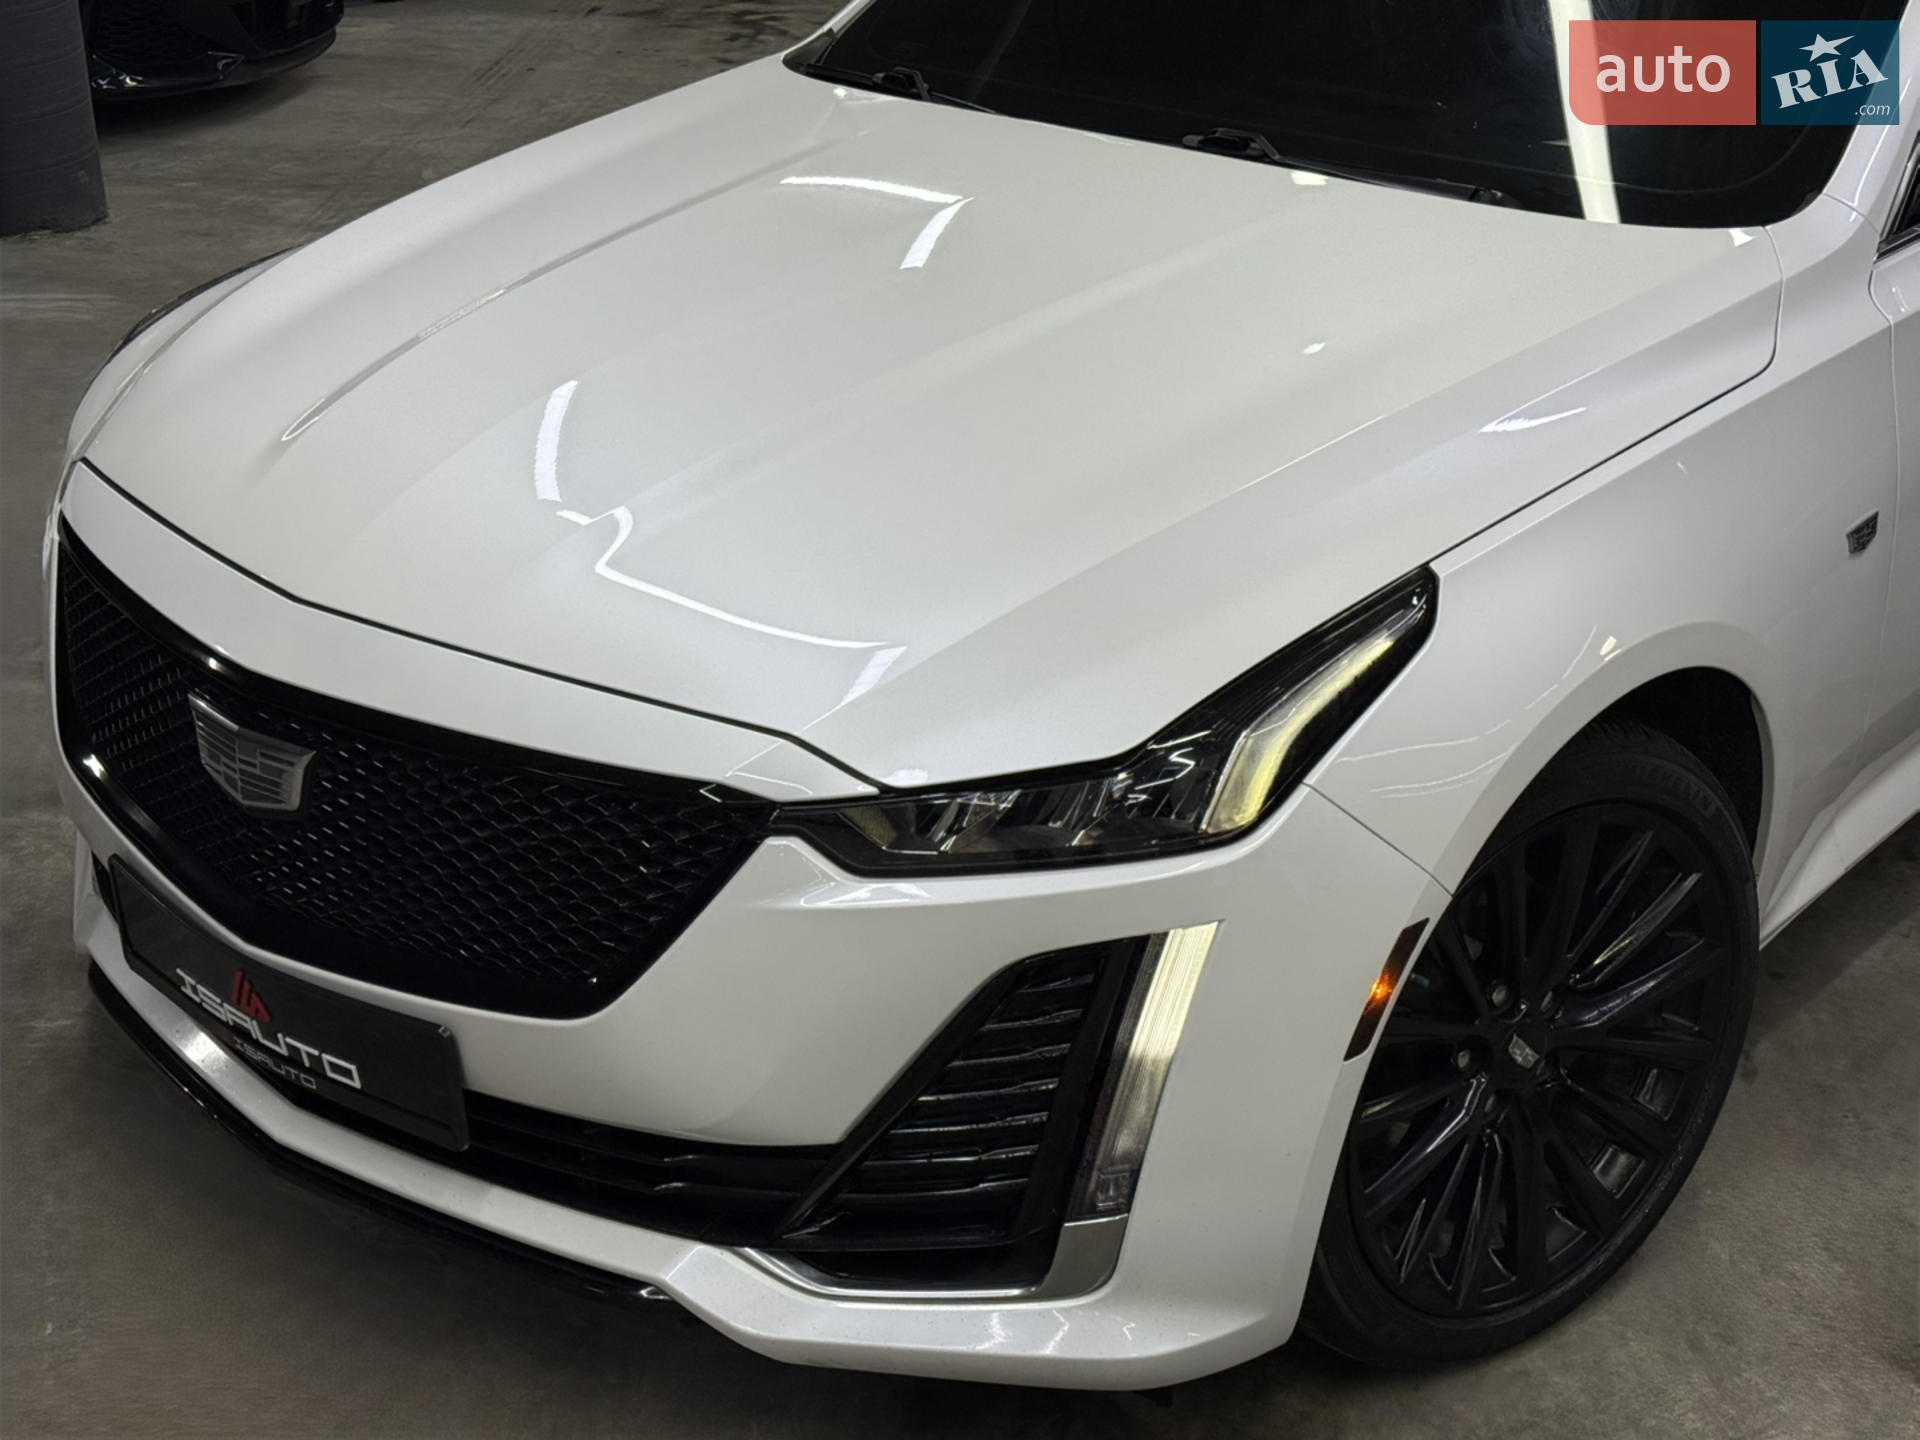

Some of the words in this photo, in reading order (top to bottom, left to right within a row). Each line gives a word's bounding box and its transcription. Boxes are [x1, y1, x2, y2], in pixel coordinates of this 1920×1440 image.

[1622, 762, 1714, 814] MICHELIN
[176, 967, 362, 1090] ISAUTO
[232, 1035, 317, 1090] ISAUTO
